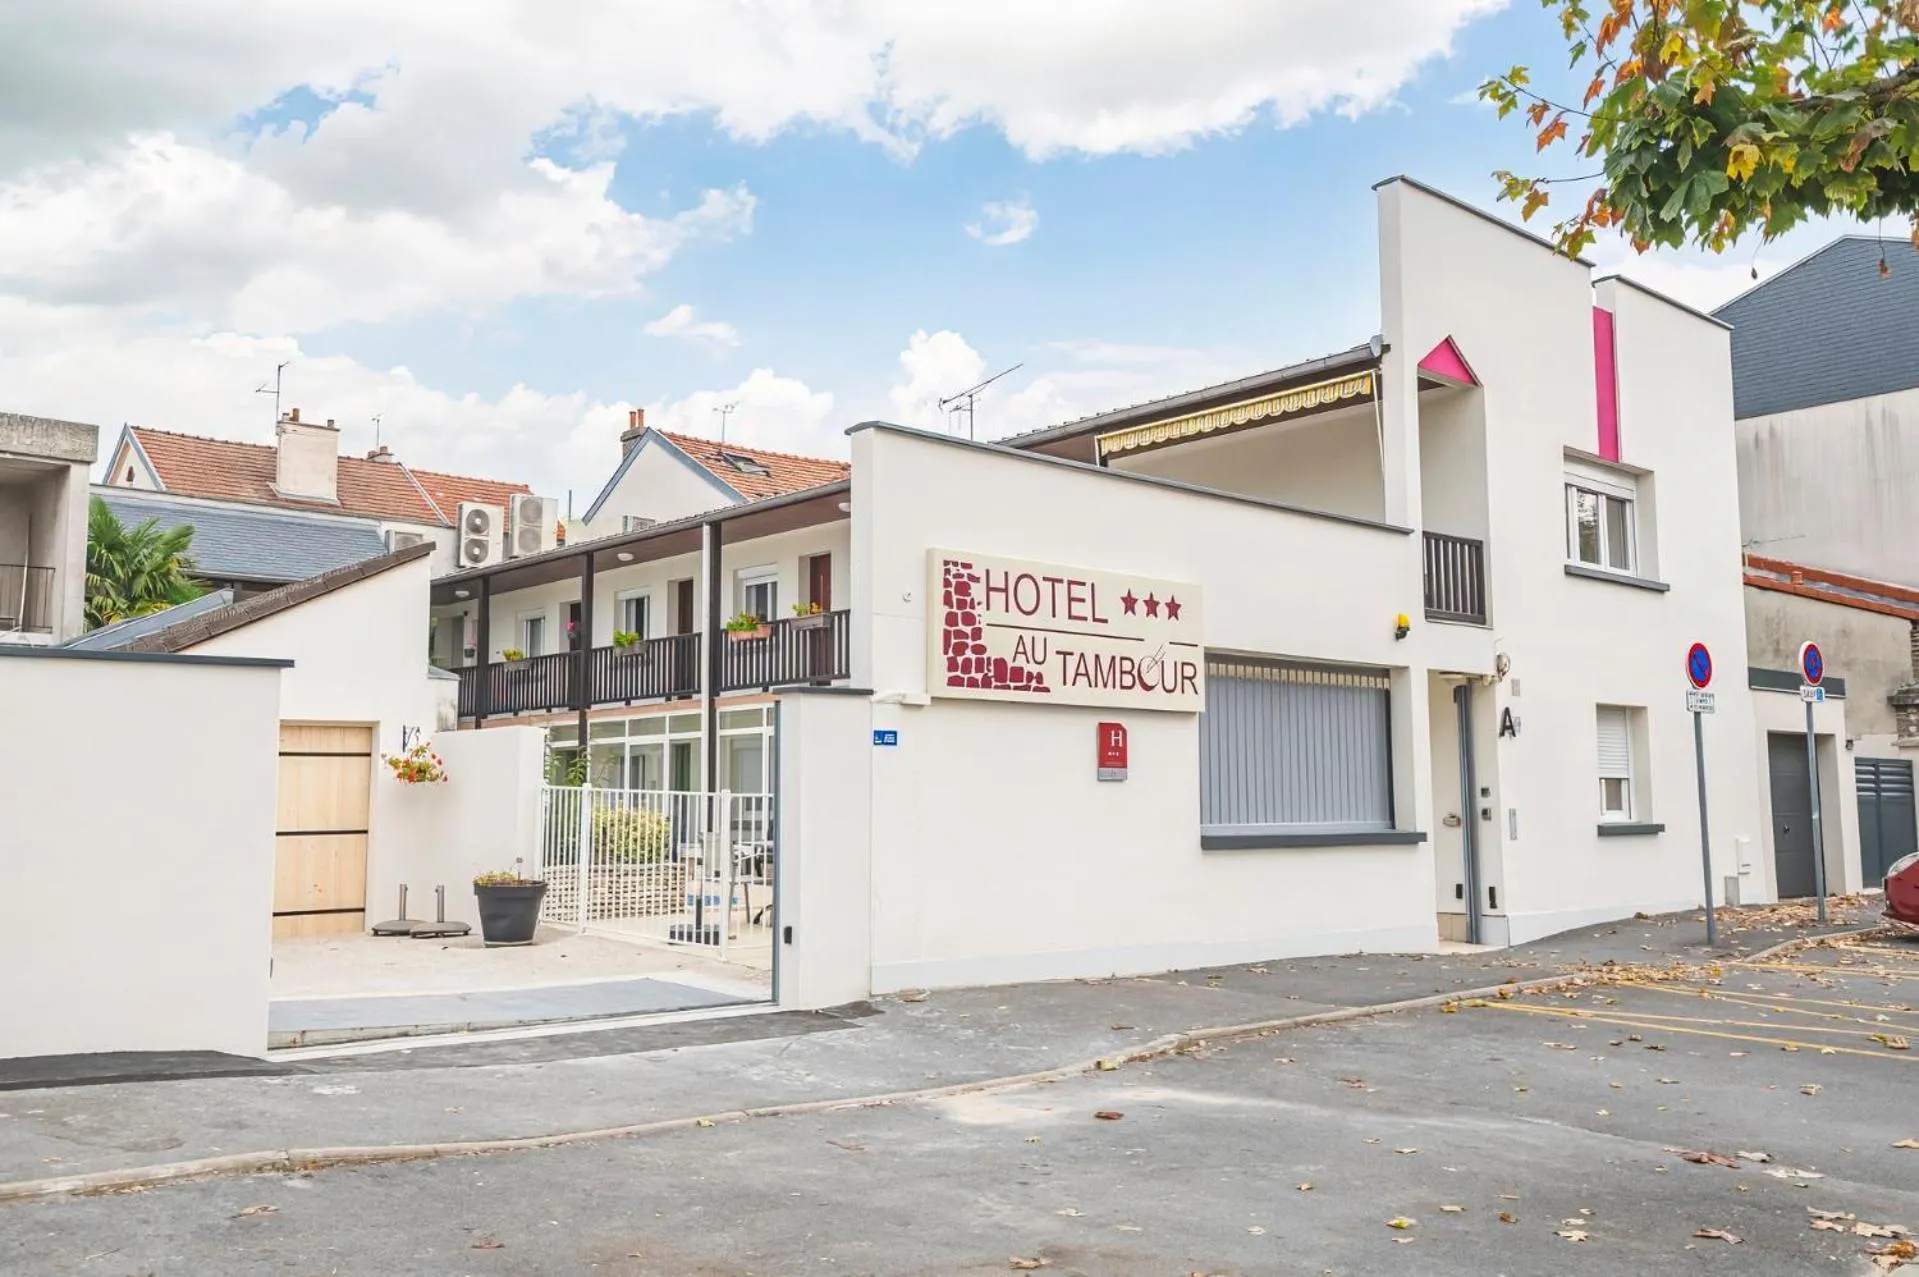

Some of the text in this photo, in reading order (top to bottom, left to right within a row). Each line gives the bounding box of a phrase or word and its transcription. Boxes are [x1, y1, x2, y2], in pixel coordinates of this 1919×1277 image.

[985, 568, 1109, 624] HOTEL
[1012, 634, 1199, 695] AU TAMBOUR
[1111, 730, 1123, 747] H
[1498, 706, 1517, 738] A
